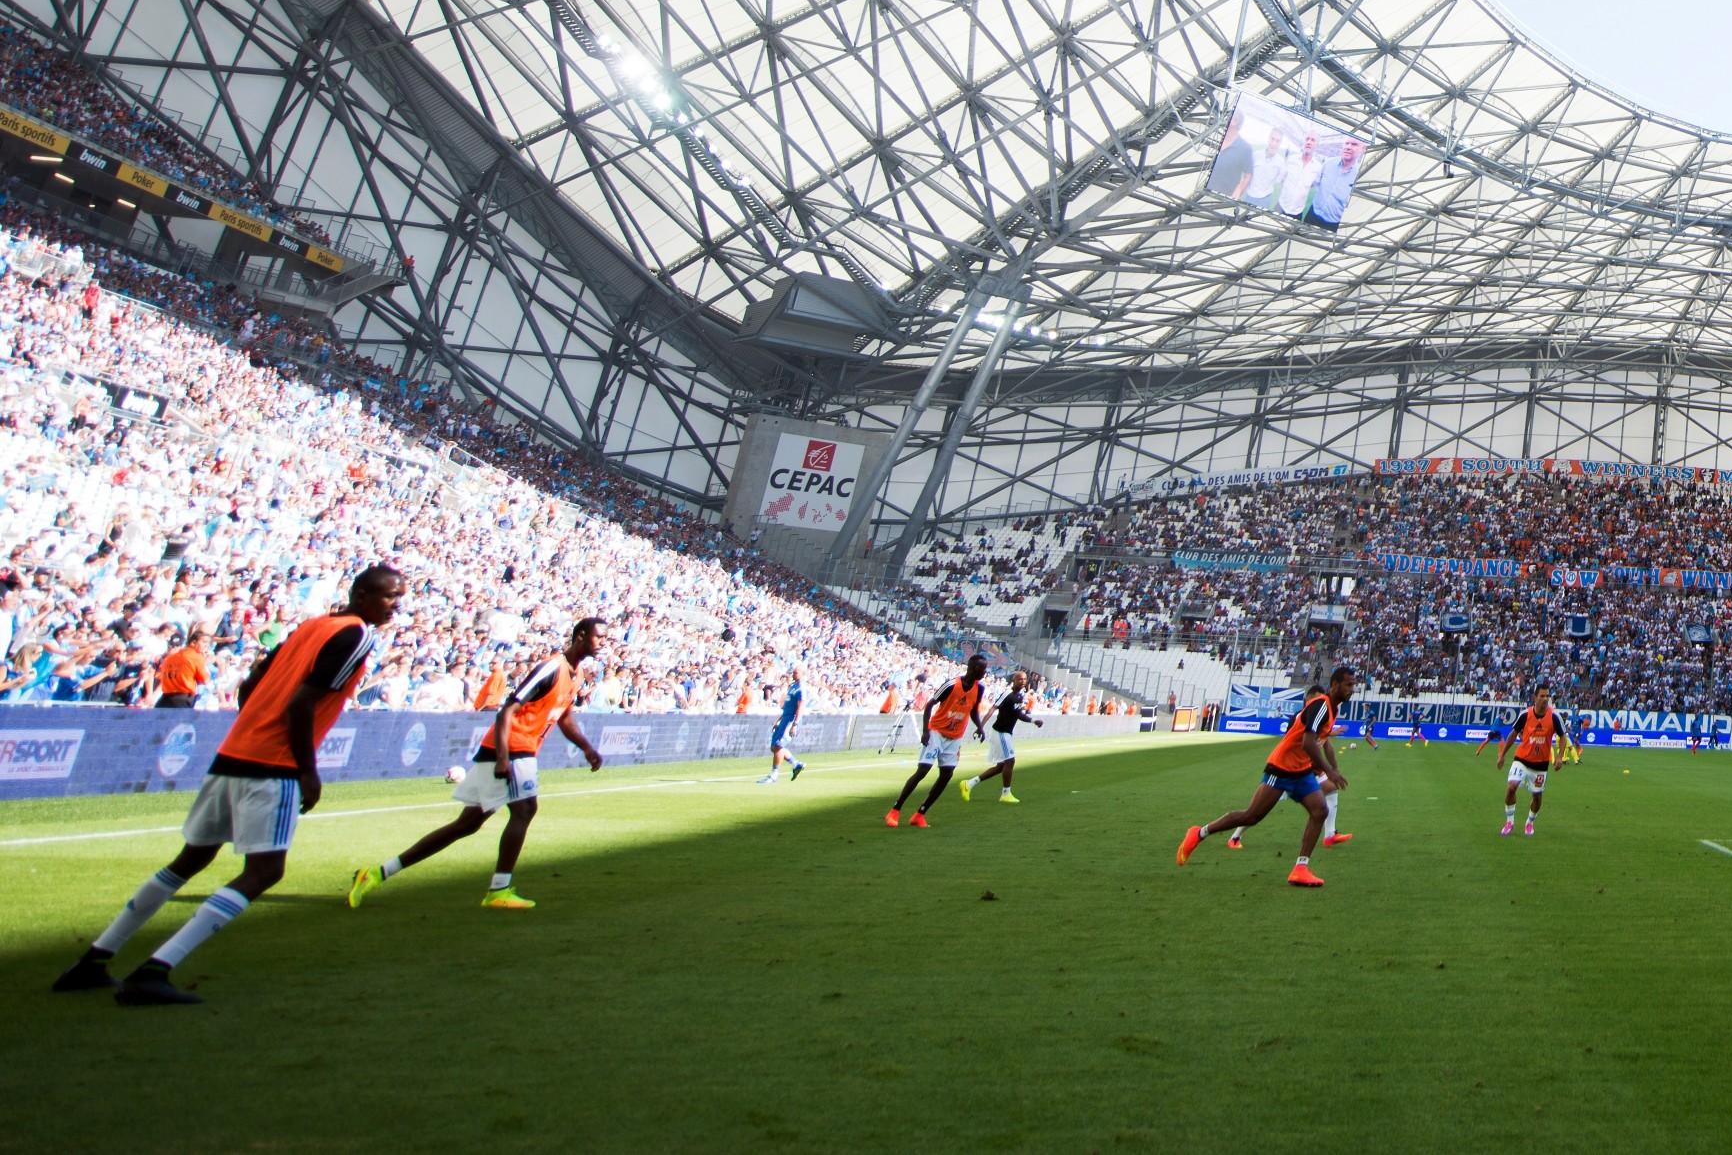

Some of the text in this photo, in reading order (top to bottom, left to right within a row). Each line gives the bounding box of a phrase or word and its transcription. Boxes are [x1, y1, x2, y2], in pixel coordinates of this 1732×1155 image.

[0, 113, 57, 147] Paris sportifs
[79, 148, 108, 170] bwin
[131, 171, 155, 189] Poker
[176, 190, 200, 210] bwin
[219, 209, 263, 236] Paris sportifs
[279, 235, 299, 252] bwin
[316, 251, 335, 266] Poker
[1161, 479, 1185, 491] CLB
[1208, 475, 1225, 486] DES
[1227, 472, 1250, 485] AMIS
[1253, 470, 1265, 482] DE
[1268, 469, 1289, 481] L'OM
[1380, 459, 1430, 474] 1987
[1461, 458, 1545, 474] SOUTH
[1581, 460, 1695, 481] WINNERS
[770, 468, 855, 498] CEPAC
[1174, 550, 1199, 561] CLUB
[1201, 552, 1219, 563] DES
[1220, 553, 1245, 564] AMIS
[1247, 554, 1261, 564] DE
[1262, 555, 1285, 566] L'OM
[1247, 699, 1295, 713] MARSEILLE
[609, 731, 649, 745] INTERSPORT
[0, 740, 78, 763] RSPORT
